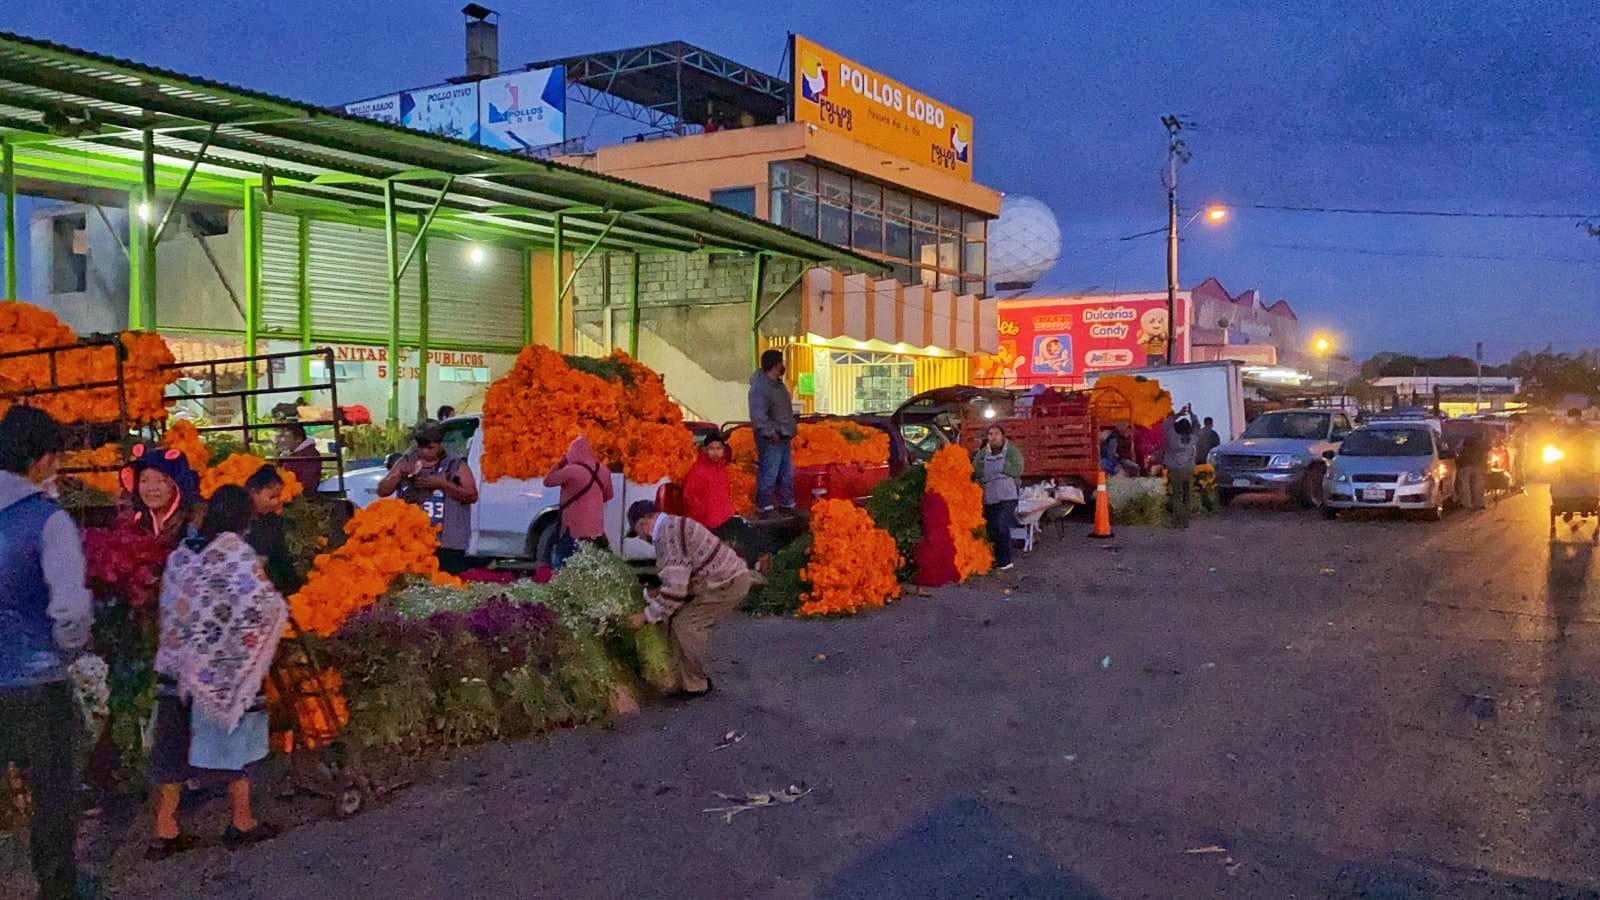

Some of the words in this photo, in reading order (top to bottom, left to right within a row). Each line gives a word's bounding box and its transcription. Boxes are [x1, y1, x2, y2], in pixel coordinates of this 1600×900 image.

[427, 91, 452, 103] POLLO
[453, 87, 472, 99] VIVO
[840, 63, 903, 112] POLLOS
[906, 94, 945, 130] LOBO
[508, 106, 544, 117] POLLOS
[820, 98, 853, 120] POLLOS
[820, 108, 853, 131] LOBO
[931, 143, 955, 160] POLLOS
[931, 150, 955, 170] LOBO
[1085, 308, 1134, 320] Dulcerías
[1092, 325, 1127, 337] Candy
[316, 345, 408, 362] SNITAR
[428, 352, 484, 366] PUBLICOS
[377, 365, 387, 379] 5
